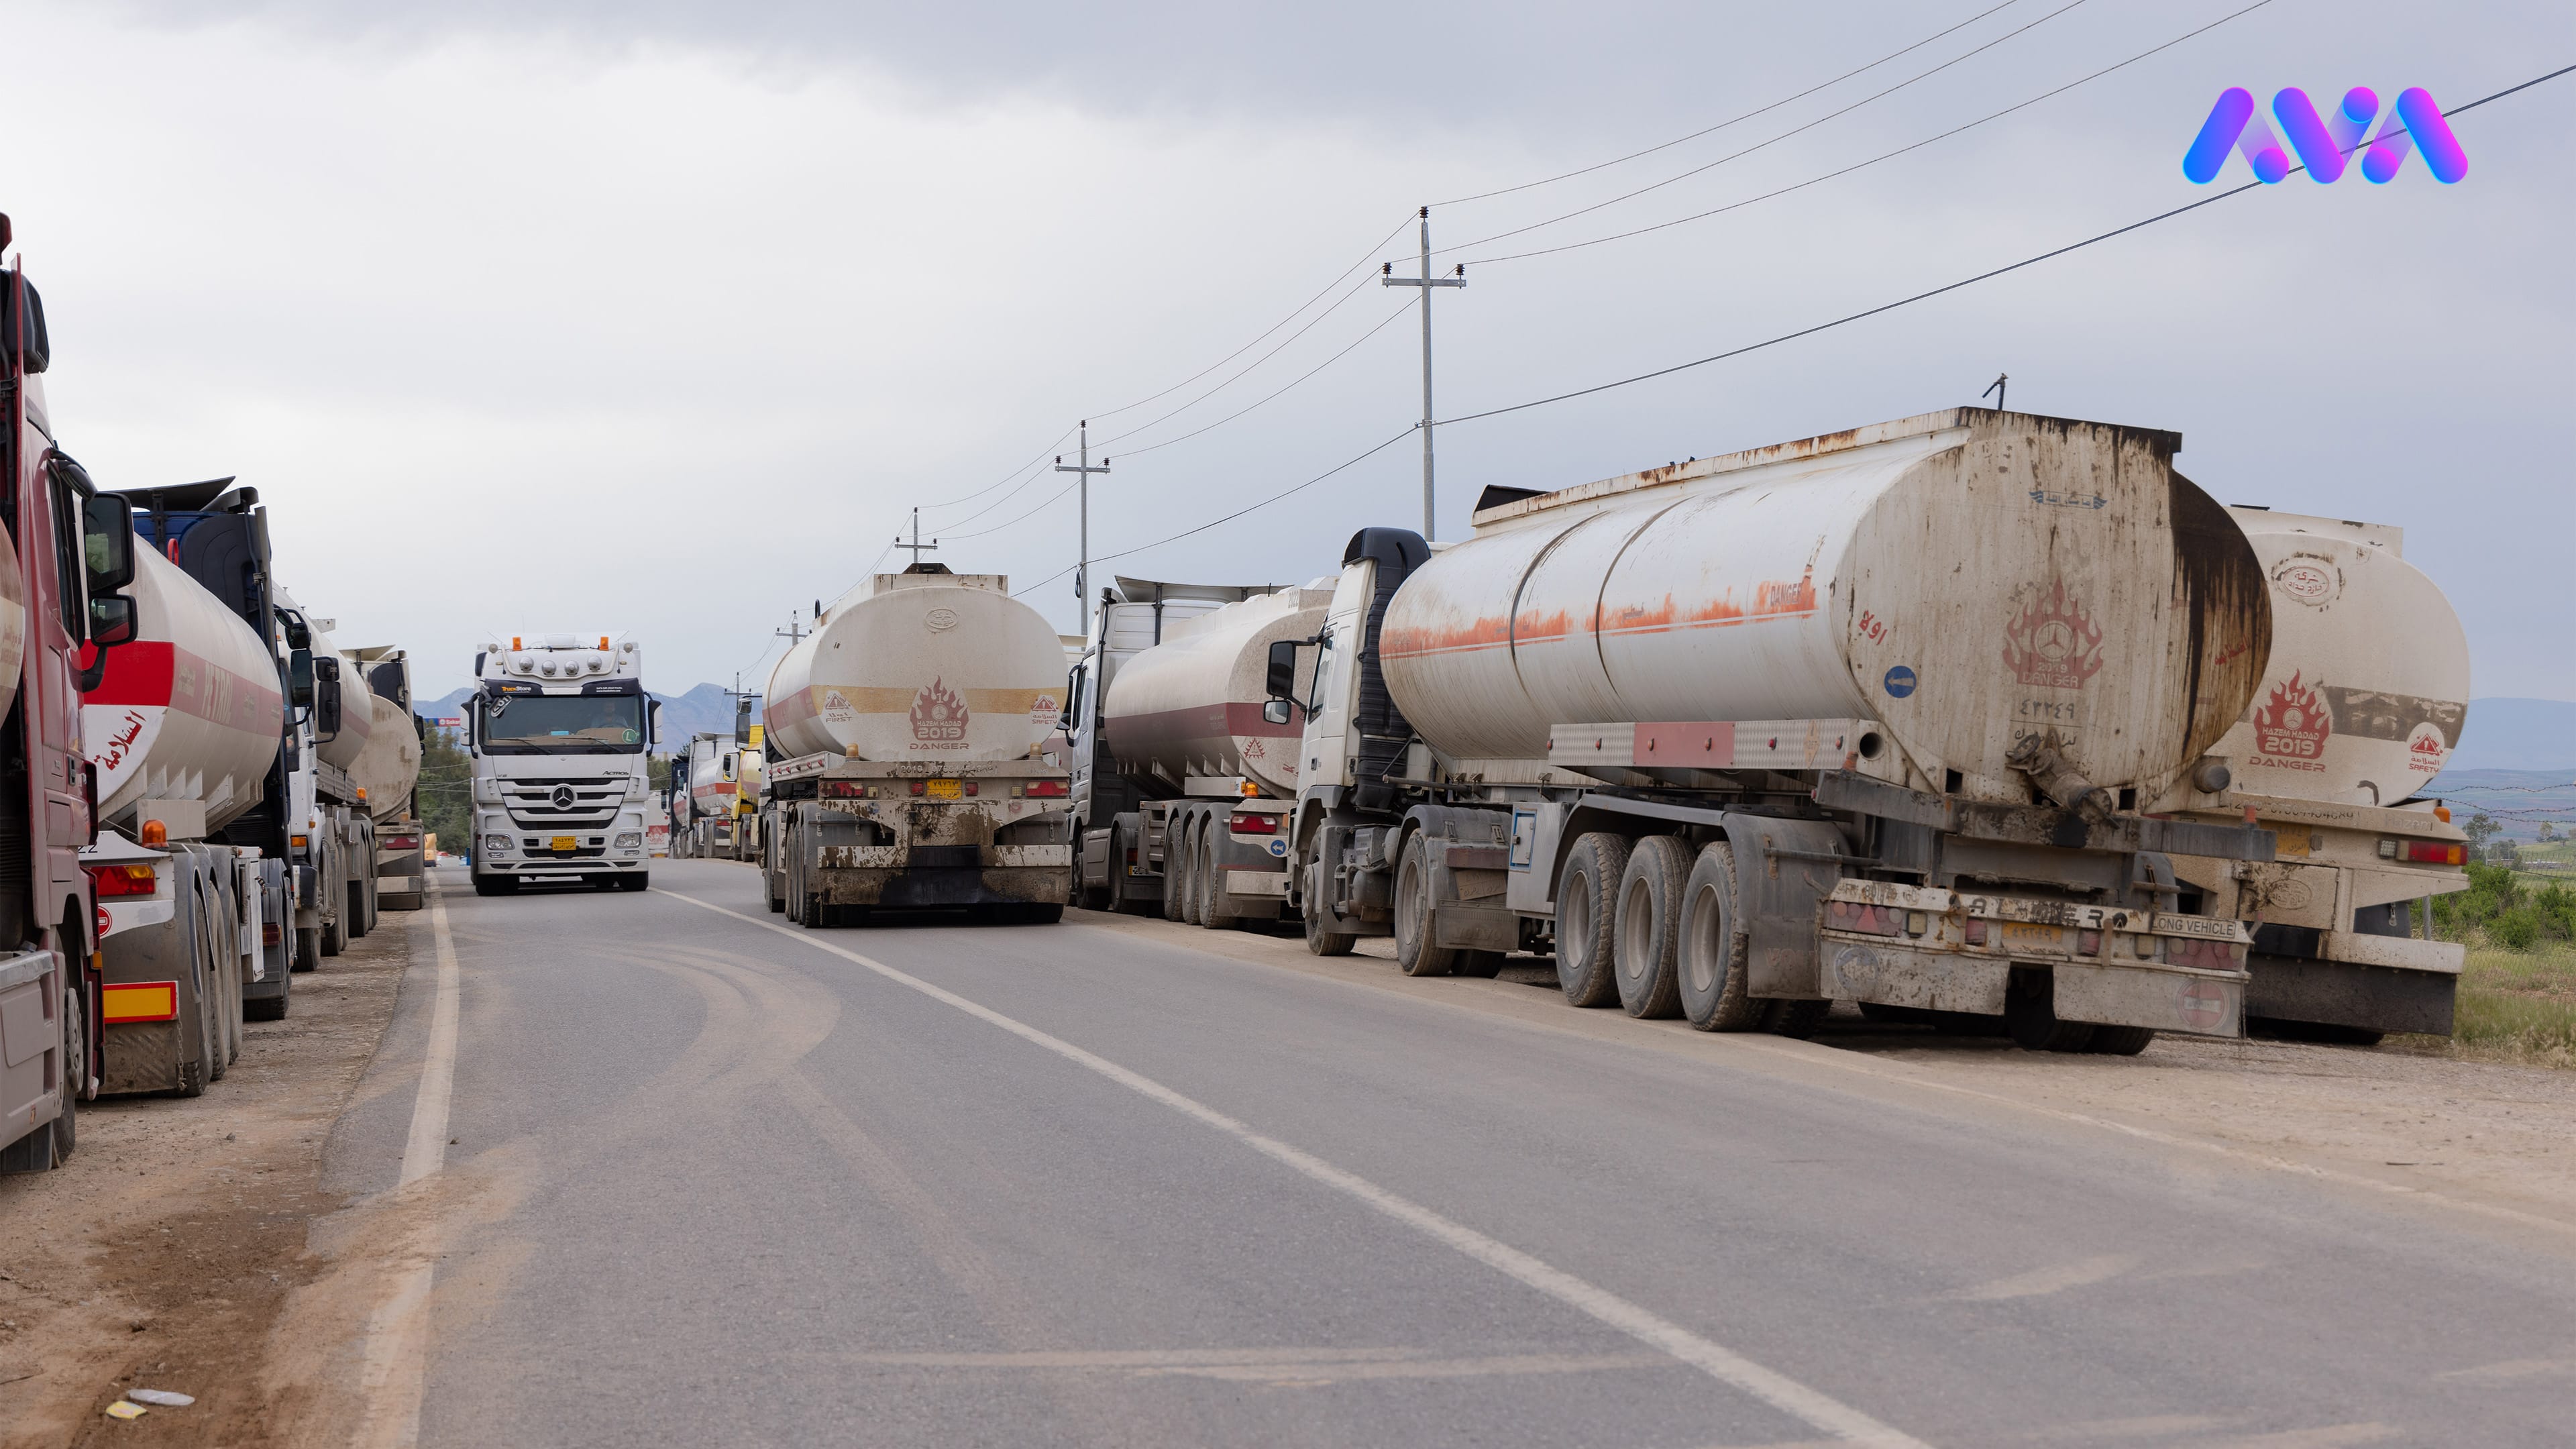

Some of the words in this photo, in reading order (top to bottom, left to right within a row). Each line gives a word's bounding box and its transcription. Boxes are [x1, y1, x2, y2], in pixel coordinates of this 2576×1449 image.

[2022, 672, 2079, 688] DANGER
[93, 709, 146, 771] السلامة
[917, 727, 961, 739] 2019
[2262, 727, 2290, 737] HAZEM
[2265, 736, 2315, 755] 2019
[2249, 756, 2326, 772] DANGER
[2409, 763, 2439, 773] SAFETY
[2187, 920, 2233, 936] VEHICLE
